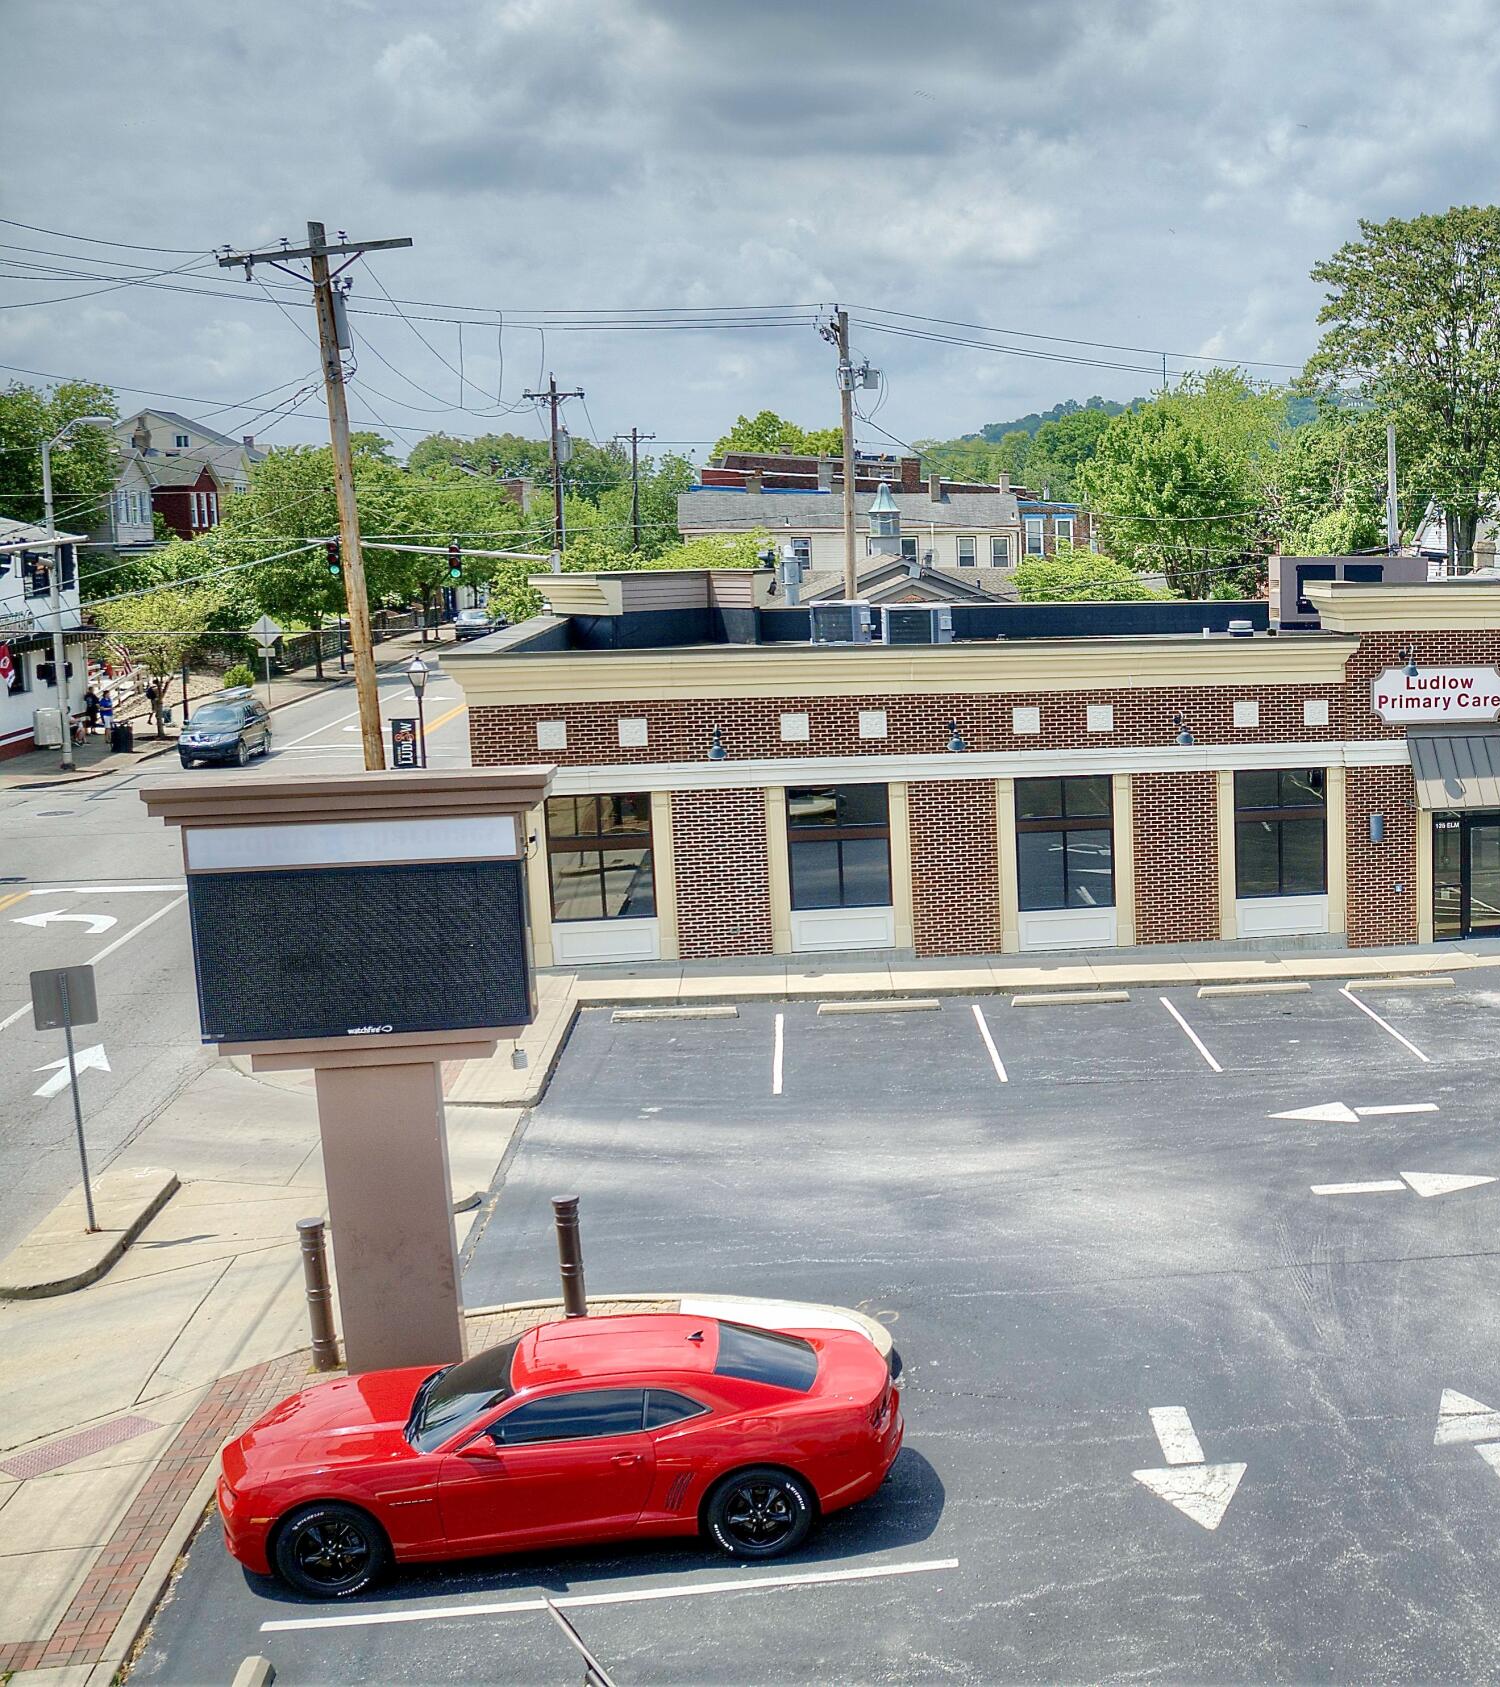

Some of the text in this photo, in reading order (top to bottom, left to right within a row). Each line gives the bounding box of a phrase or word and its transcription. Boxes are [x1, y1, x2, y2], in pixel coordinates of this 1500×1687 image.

[1406, 675, 1474, 690] Ludlow
[1378, 692, 1500, 711] Primary Care
[1446, 821, 1460, 829] ELM
